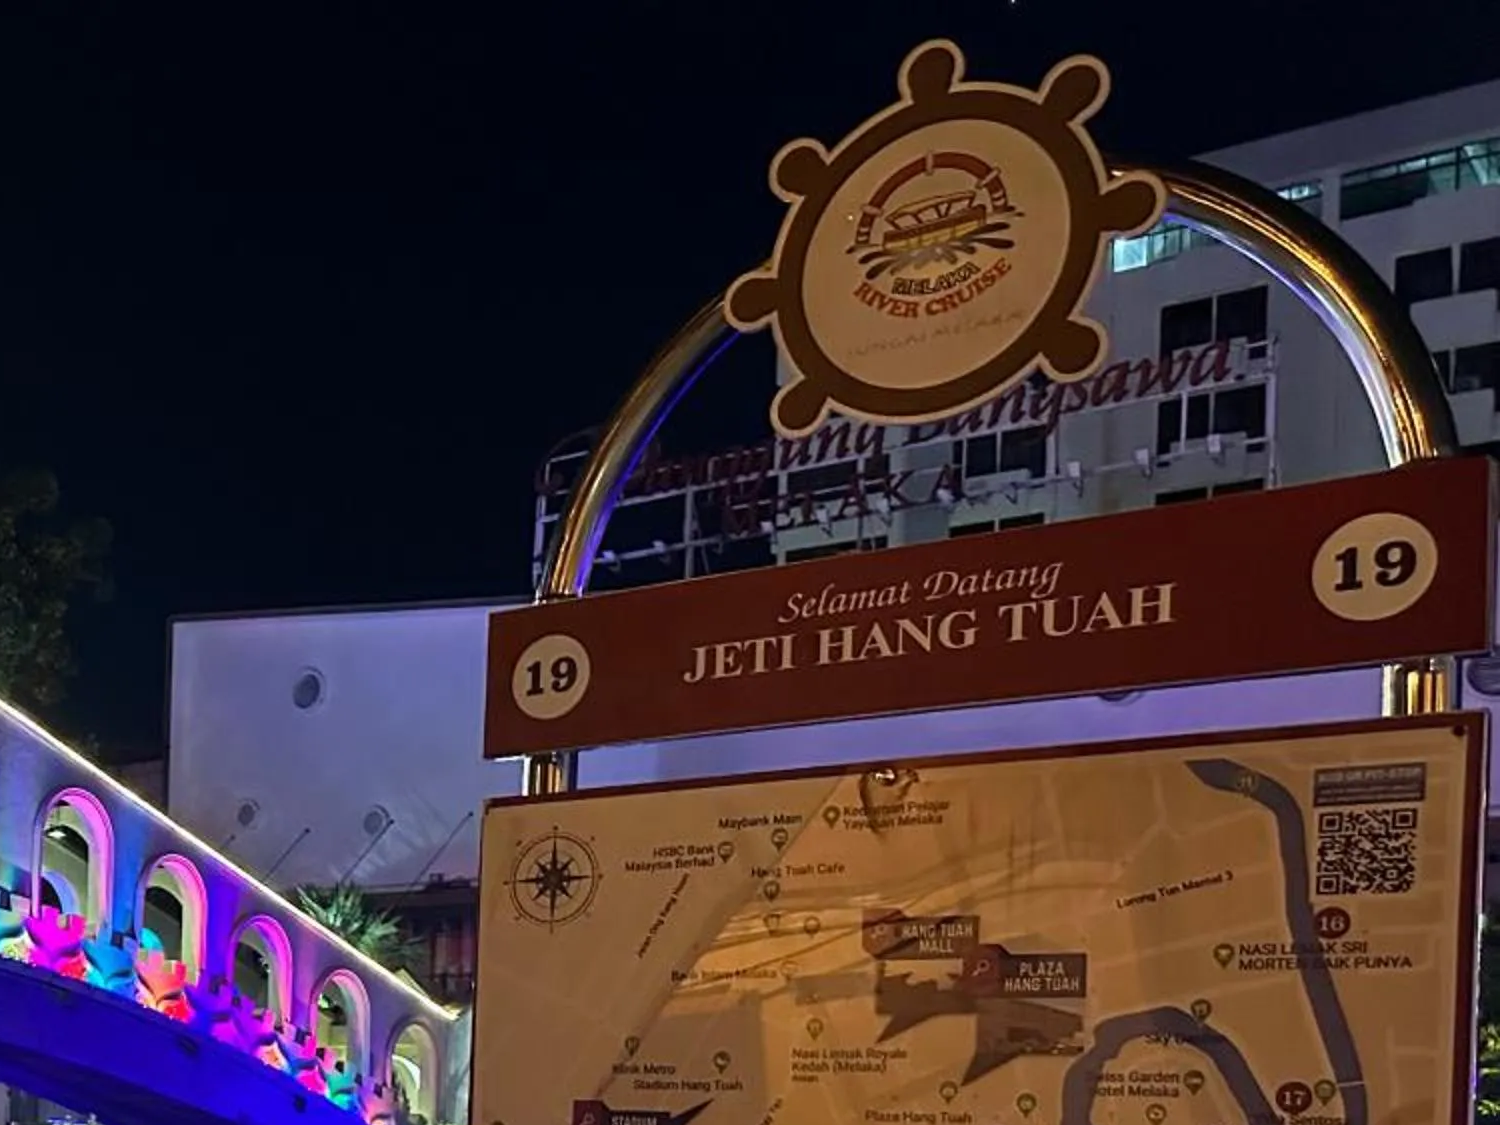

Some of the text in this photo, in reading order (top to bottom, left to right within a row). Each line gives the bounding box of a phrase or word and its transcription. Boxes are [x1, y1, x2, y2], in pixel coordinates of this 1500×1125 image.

[891, 261, 981, 295] MELAKA
[852, 257, 1012, 318] RIVER CRUISE
[1333, 539, 1418, 591] 19
[777, 560, 1065, 624] Selamat Datang
[683, 581, 1180, 684] JETI HANG TUAH
[526, 655, 578, 697] 19
[717, 815, 769, 831] Maybank
[652, 844, 715, 858] HSBC Bank
[625, 856, 715, 874] Malaysia Berhad
[1116, 889, 1156, 909] Lorong
[1158, 884, 1181, 899] Tun
[902, 922, 974, 939] HANG TUAH
[1319, 916, 1345, 932] 16
[919, 938, 954, 954] MALL
[1238, 942, 1277, 956] NASI
[1341, 941, 1368, 954] SRI
[1019, 961, 1065, 977] PLAZA
[1353, 955, 1413, 969] PUNYA
[1004, 977, 1080, 992] HANG TUAH
[791, 1047, 819, 1059] Nasi
[643, 1063, 676, 1075] Metro
[791, 1061, 887, 1075] Kedah (Melaka)
[1128, 1070, 1180, 1083] Garden
[633, 1079, 743, 1092] Stadium Hang Tuah
[1127, 1085, 1180, 1098] Melaka
[1283, 1091, 1307, 1106] 17
[864, 1110, 972, 1125] Plaza Hang Tuah
